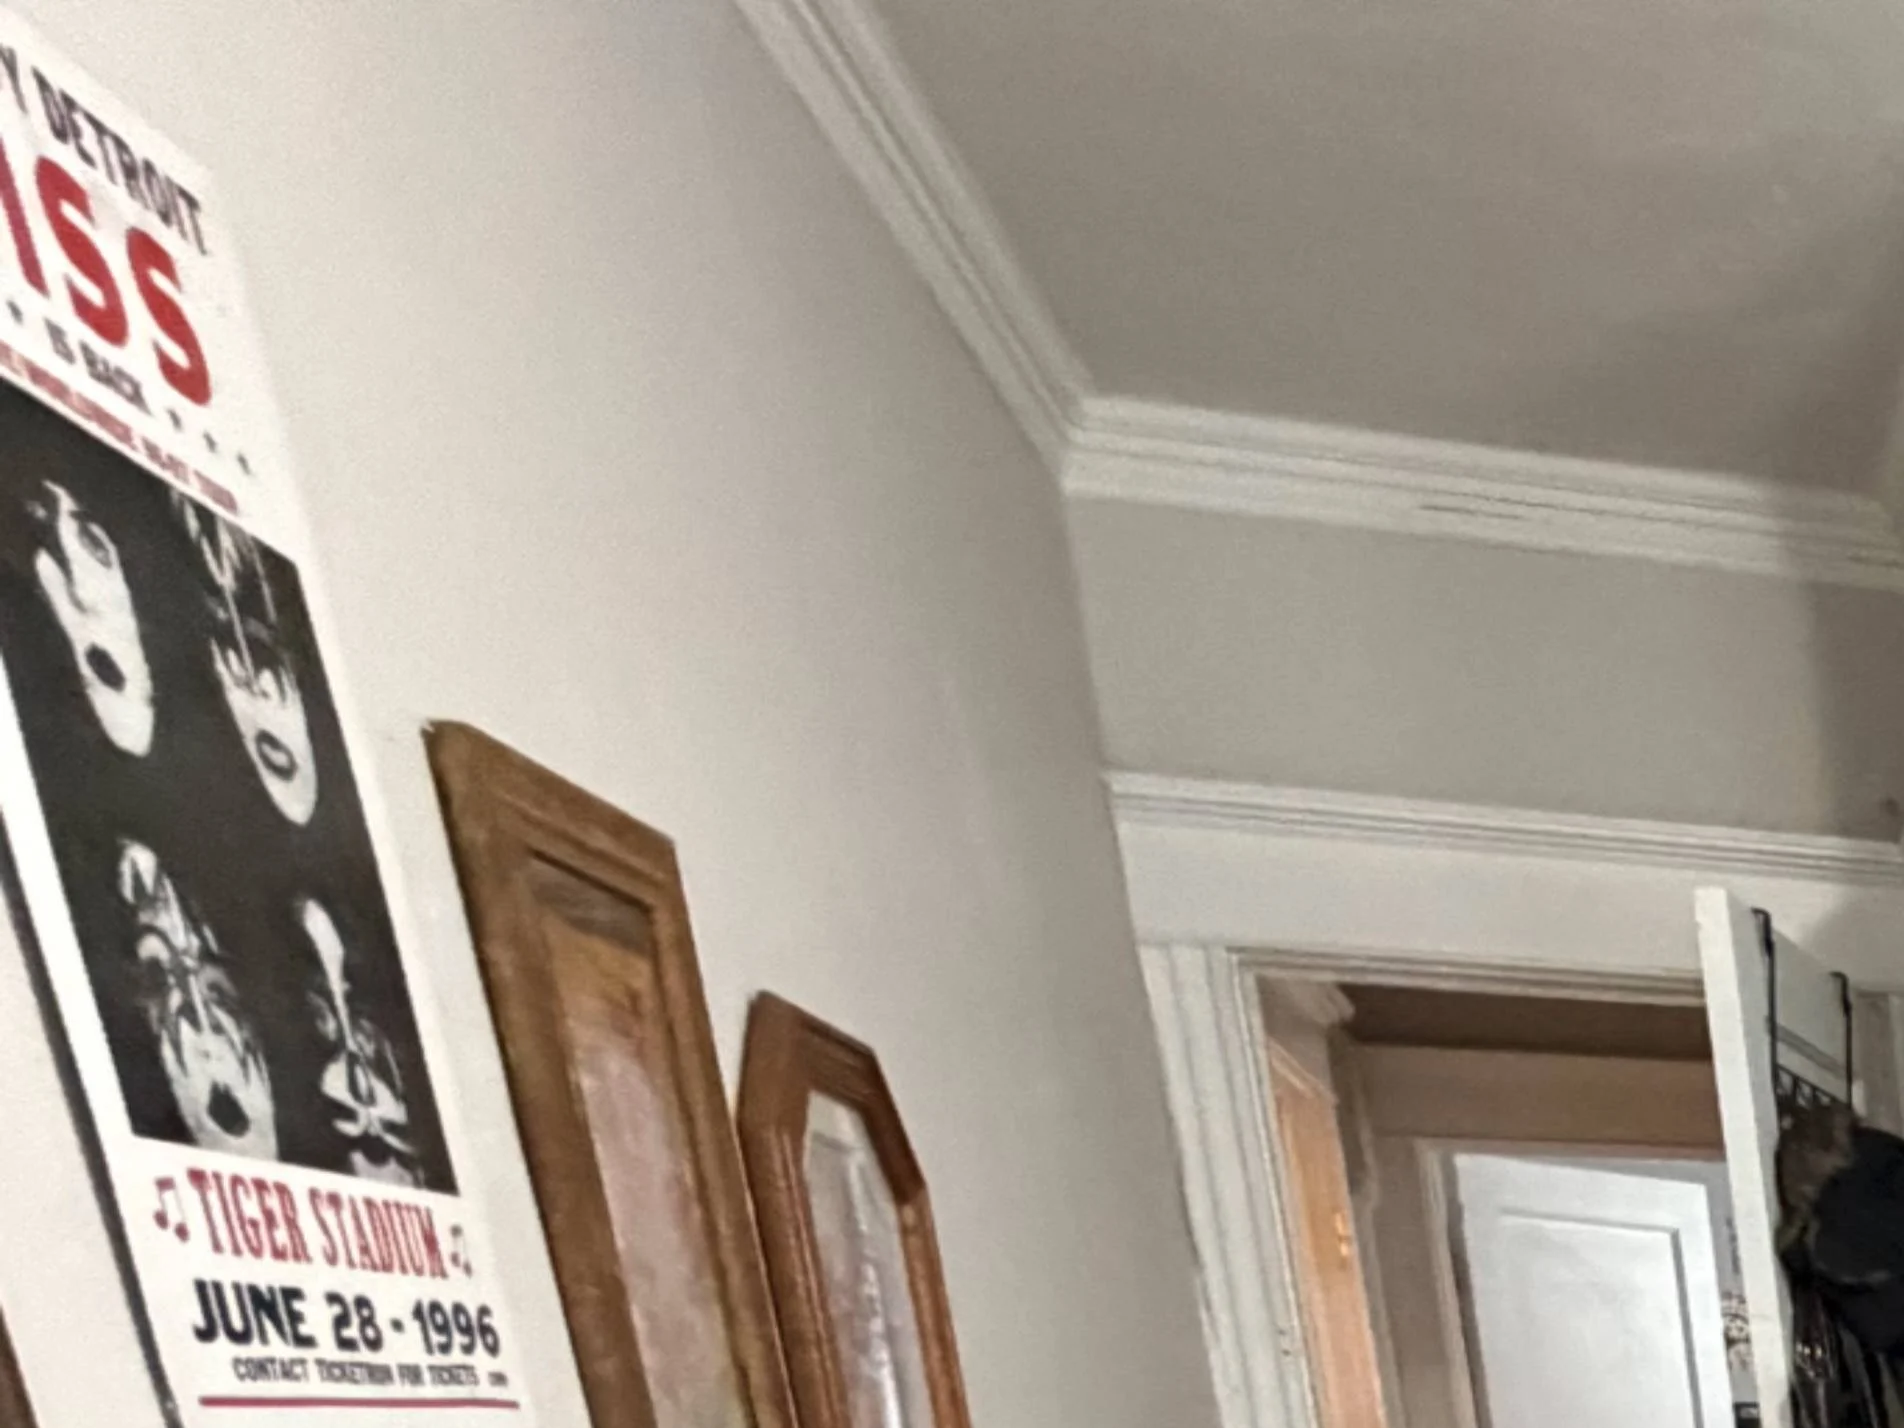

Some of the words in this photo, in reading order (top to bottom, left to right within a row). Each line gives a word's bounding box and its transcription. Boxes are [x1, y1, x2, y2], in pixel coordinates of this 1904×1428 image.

[31, 64, 207, 256] DETROIT
[186, 1167, 312, 1264] TIGER
[308, 1187, 449, 1280] STADIUM
[193, 1278, 318, 1350] JUNE
[323, 1290, 384, 1353] 28
[411, 1298, 501, 1359] 1996
[231, 1356, 309, 1384] CONTACT
